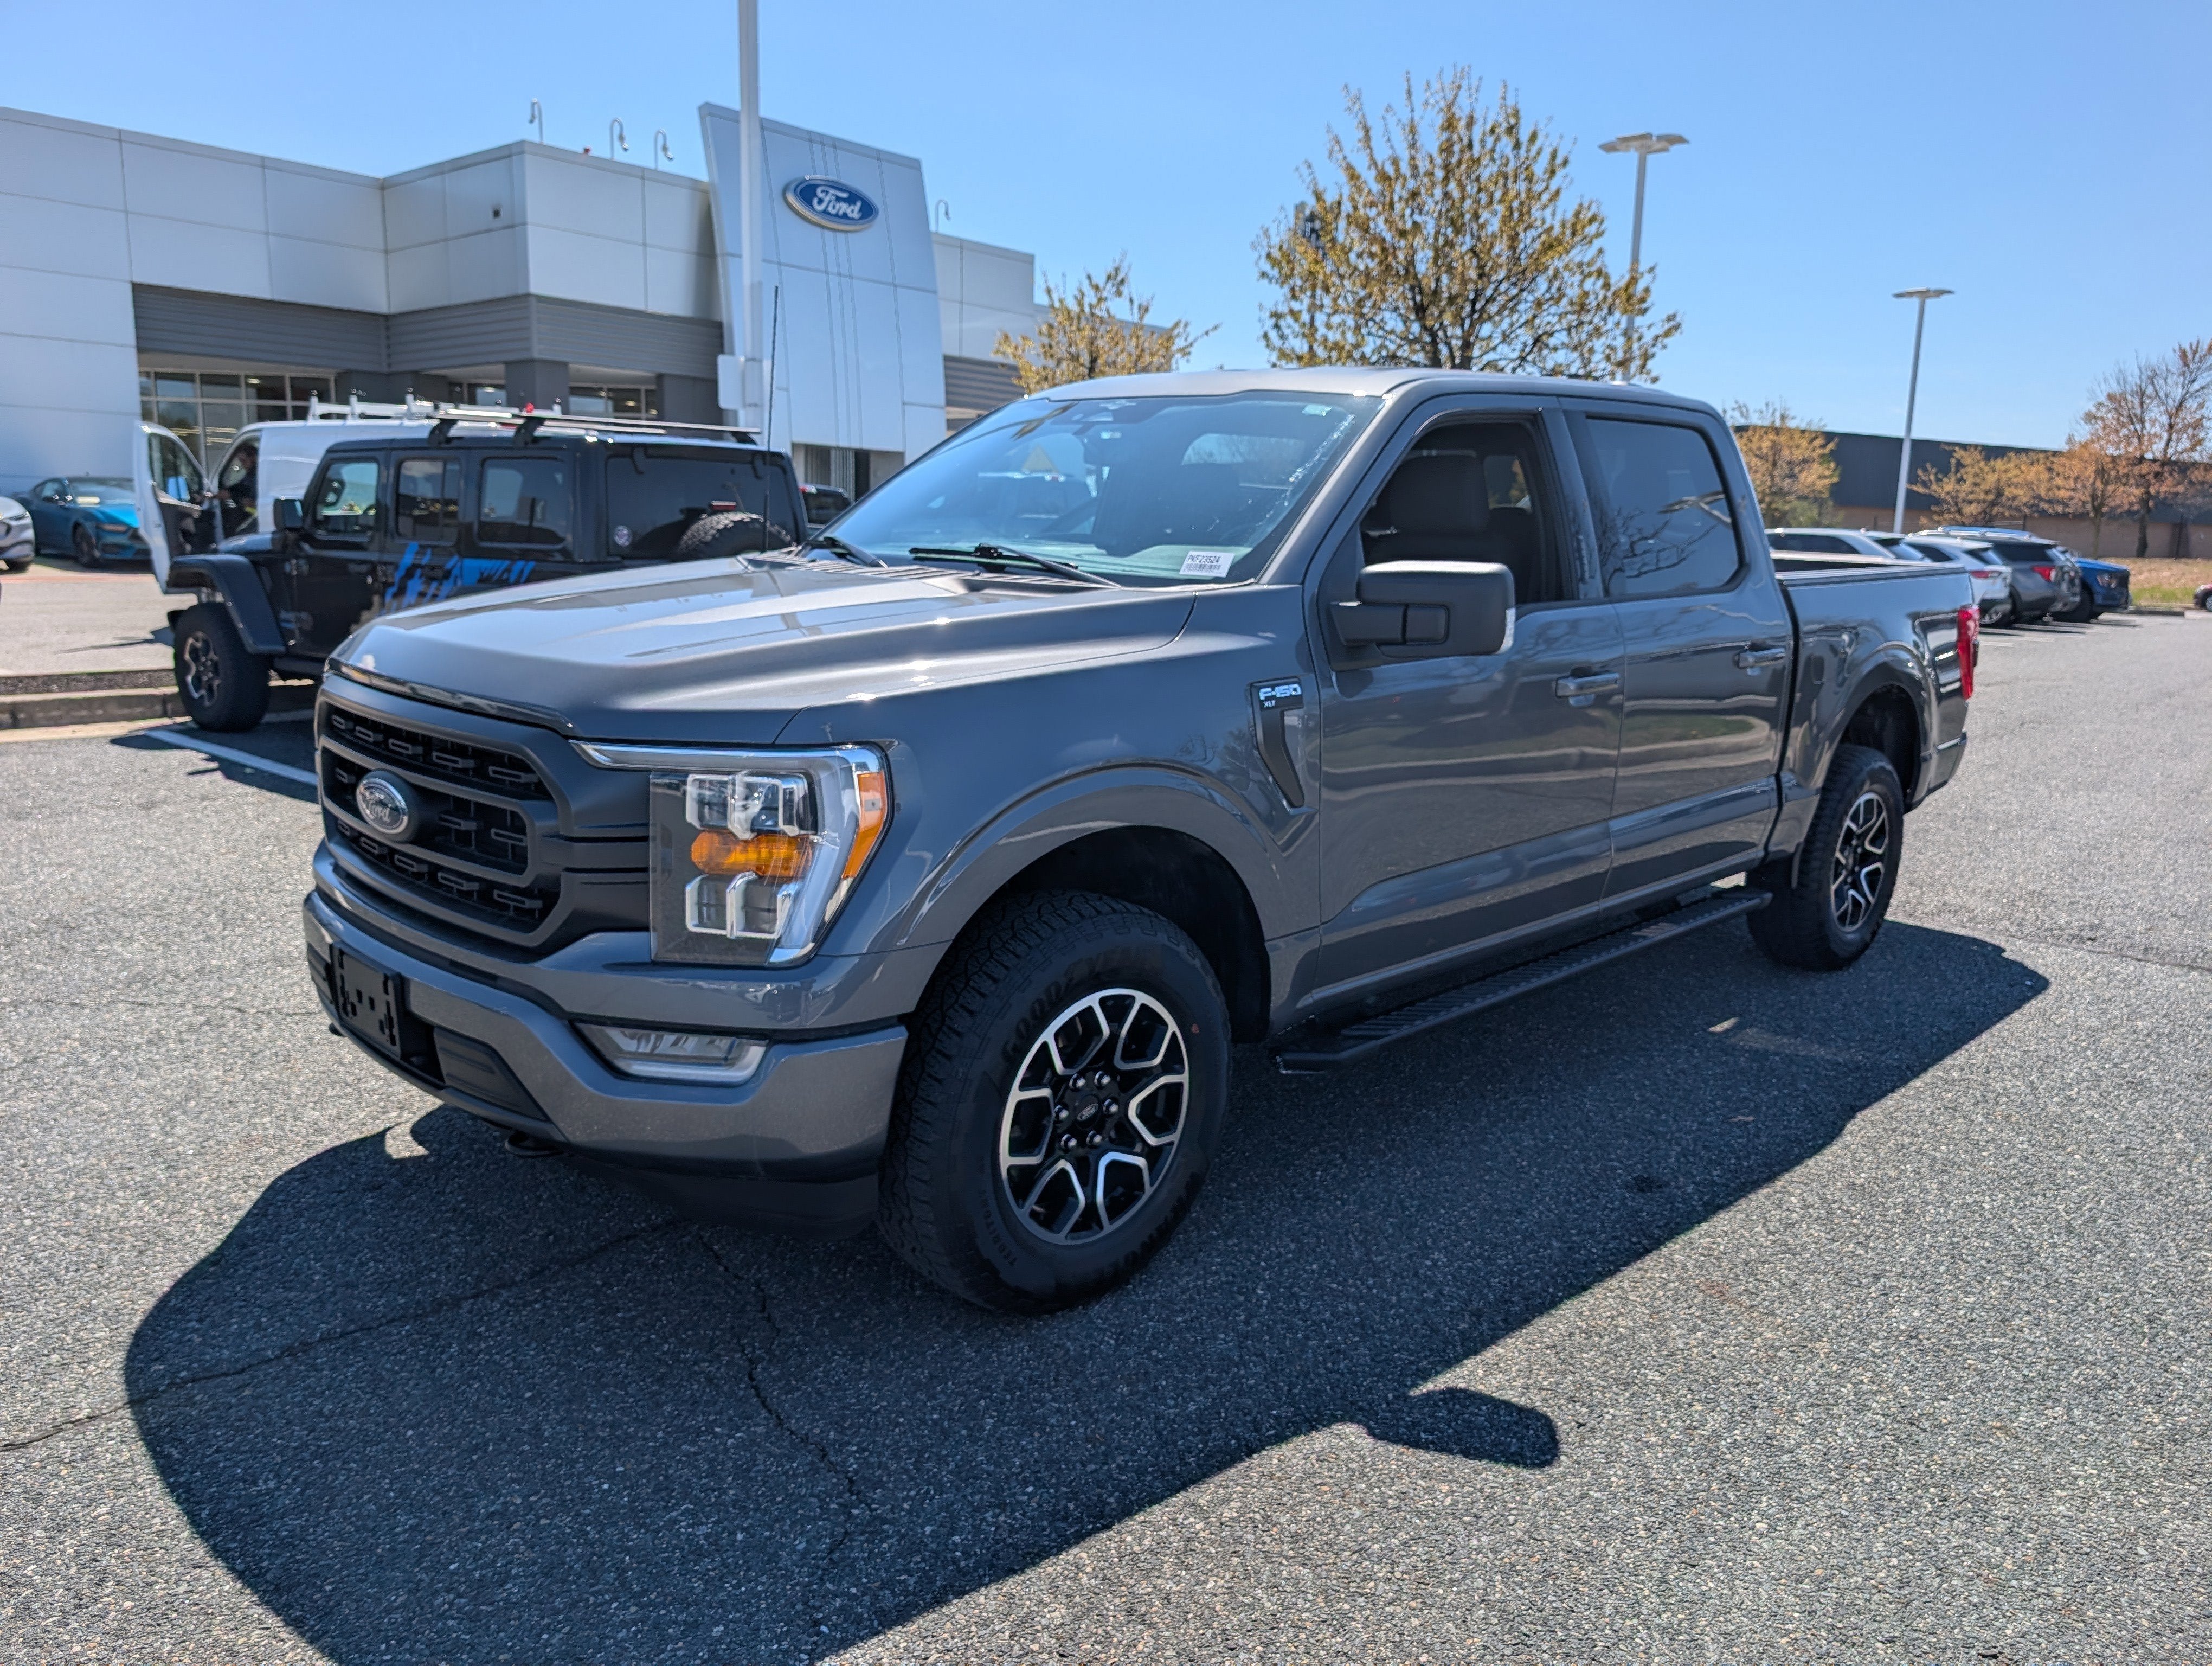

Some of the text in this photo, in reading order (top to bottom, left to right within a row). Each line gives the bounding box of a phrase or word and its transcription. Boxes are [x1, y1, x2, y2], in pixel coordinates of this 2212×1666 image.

[812, 185, 863, 220] Ford
[1259, 683, 1302, 700] F-150
[1263, 700, 1276, 708] XLT
